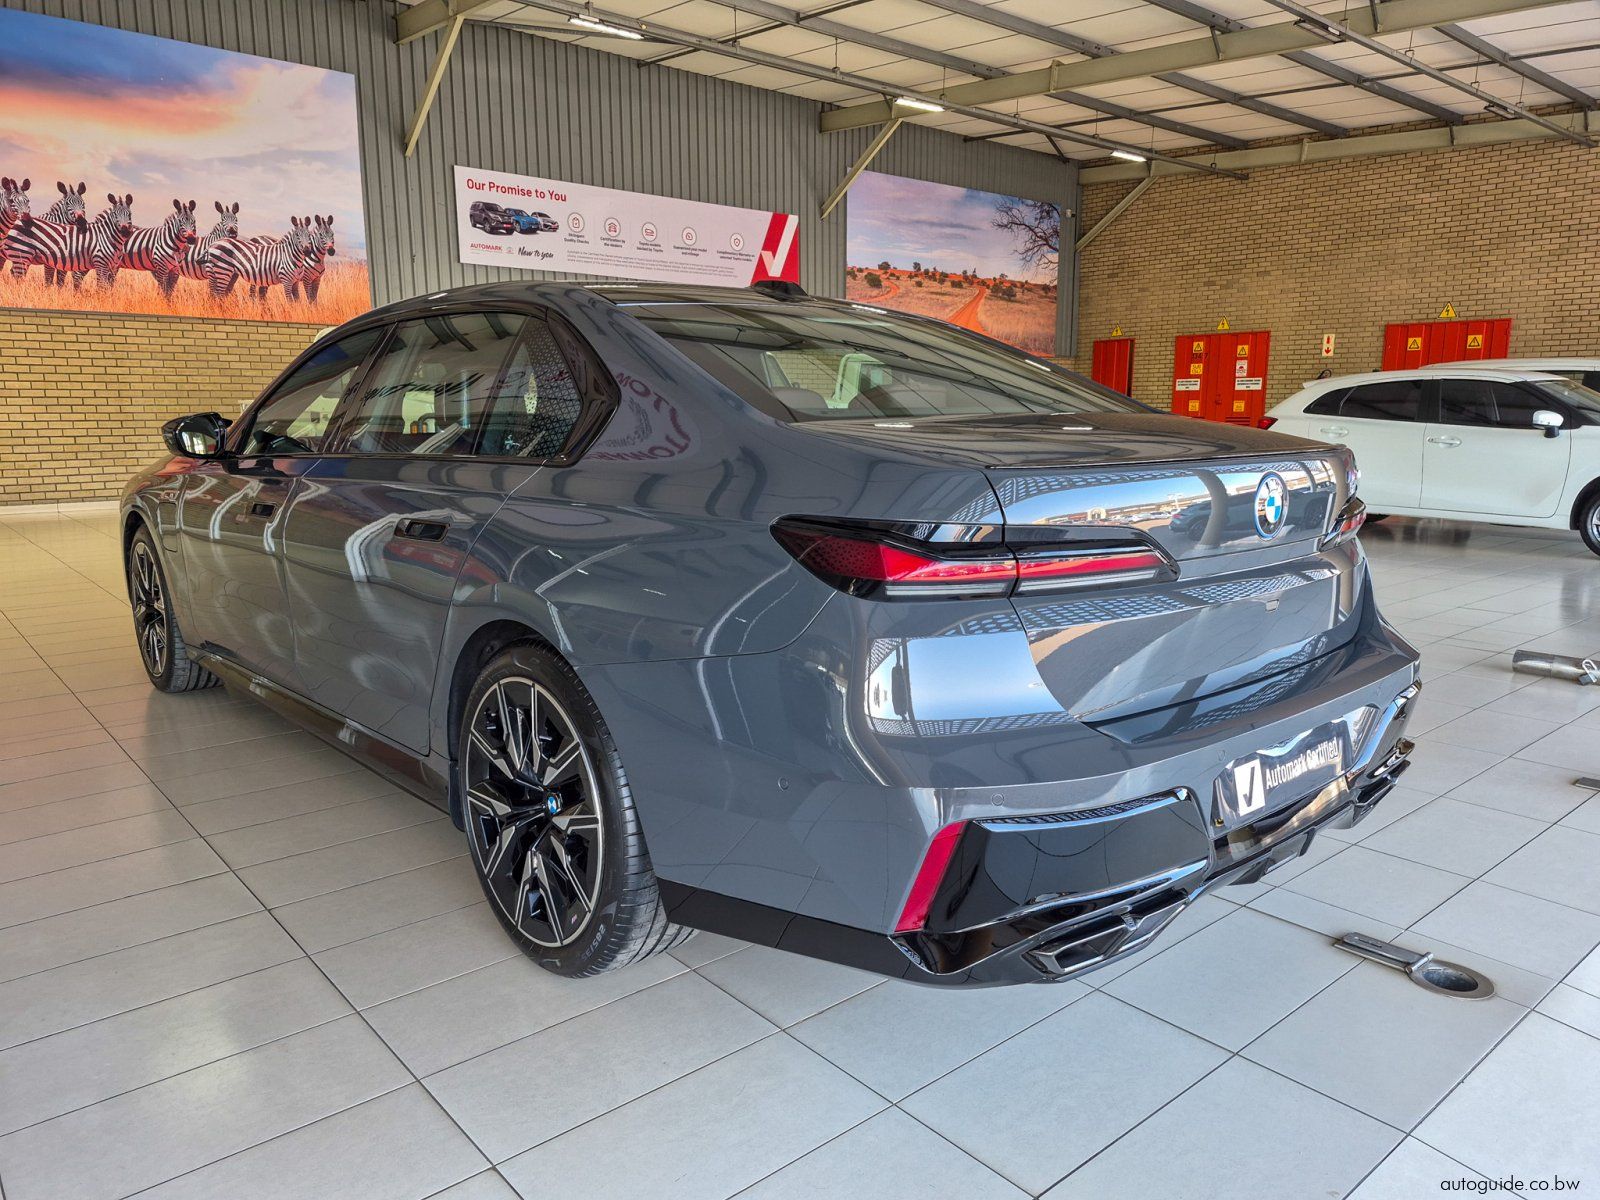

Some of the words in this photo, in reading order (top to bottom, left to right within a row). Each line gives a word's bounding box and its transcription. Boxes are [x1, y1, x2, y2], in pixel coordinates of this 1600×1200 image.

[467, 178, 486, 191] Our
[489, 181, 532, 197] Promise
[535, 189, 546, 199] to
[548, 190, 567, 202] You
[470, 243, 503, 251] AUTOMARK
[517, 246, 533, 257] New
[541, 252, 554, 261] you
[1266, 753, 1307, 790] Automark
[1306, 736, 1339, 770] Certified
